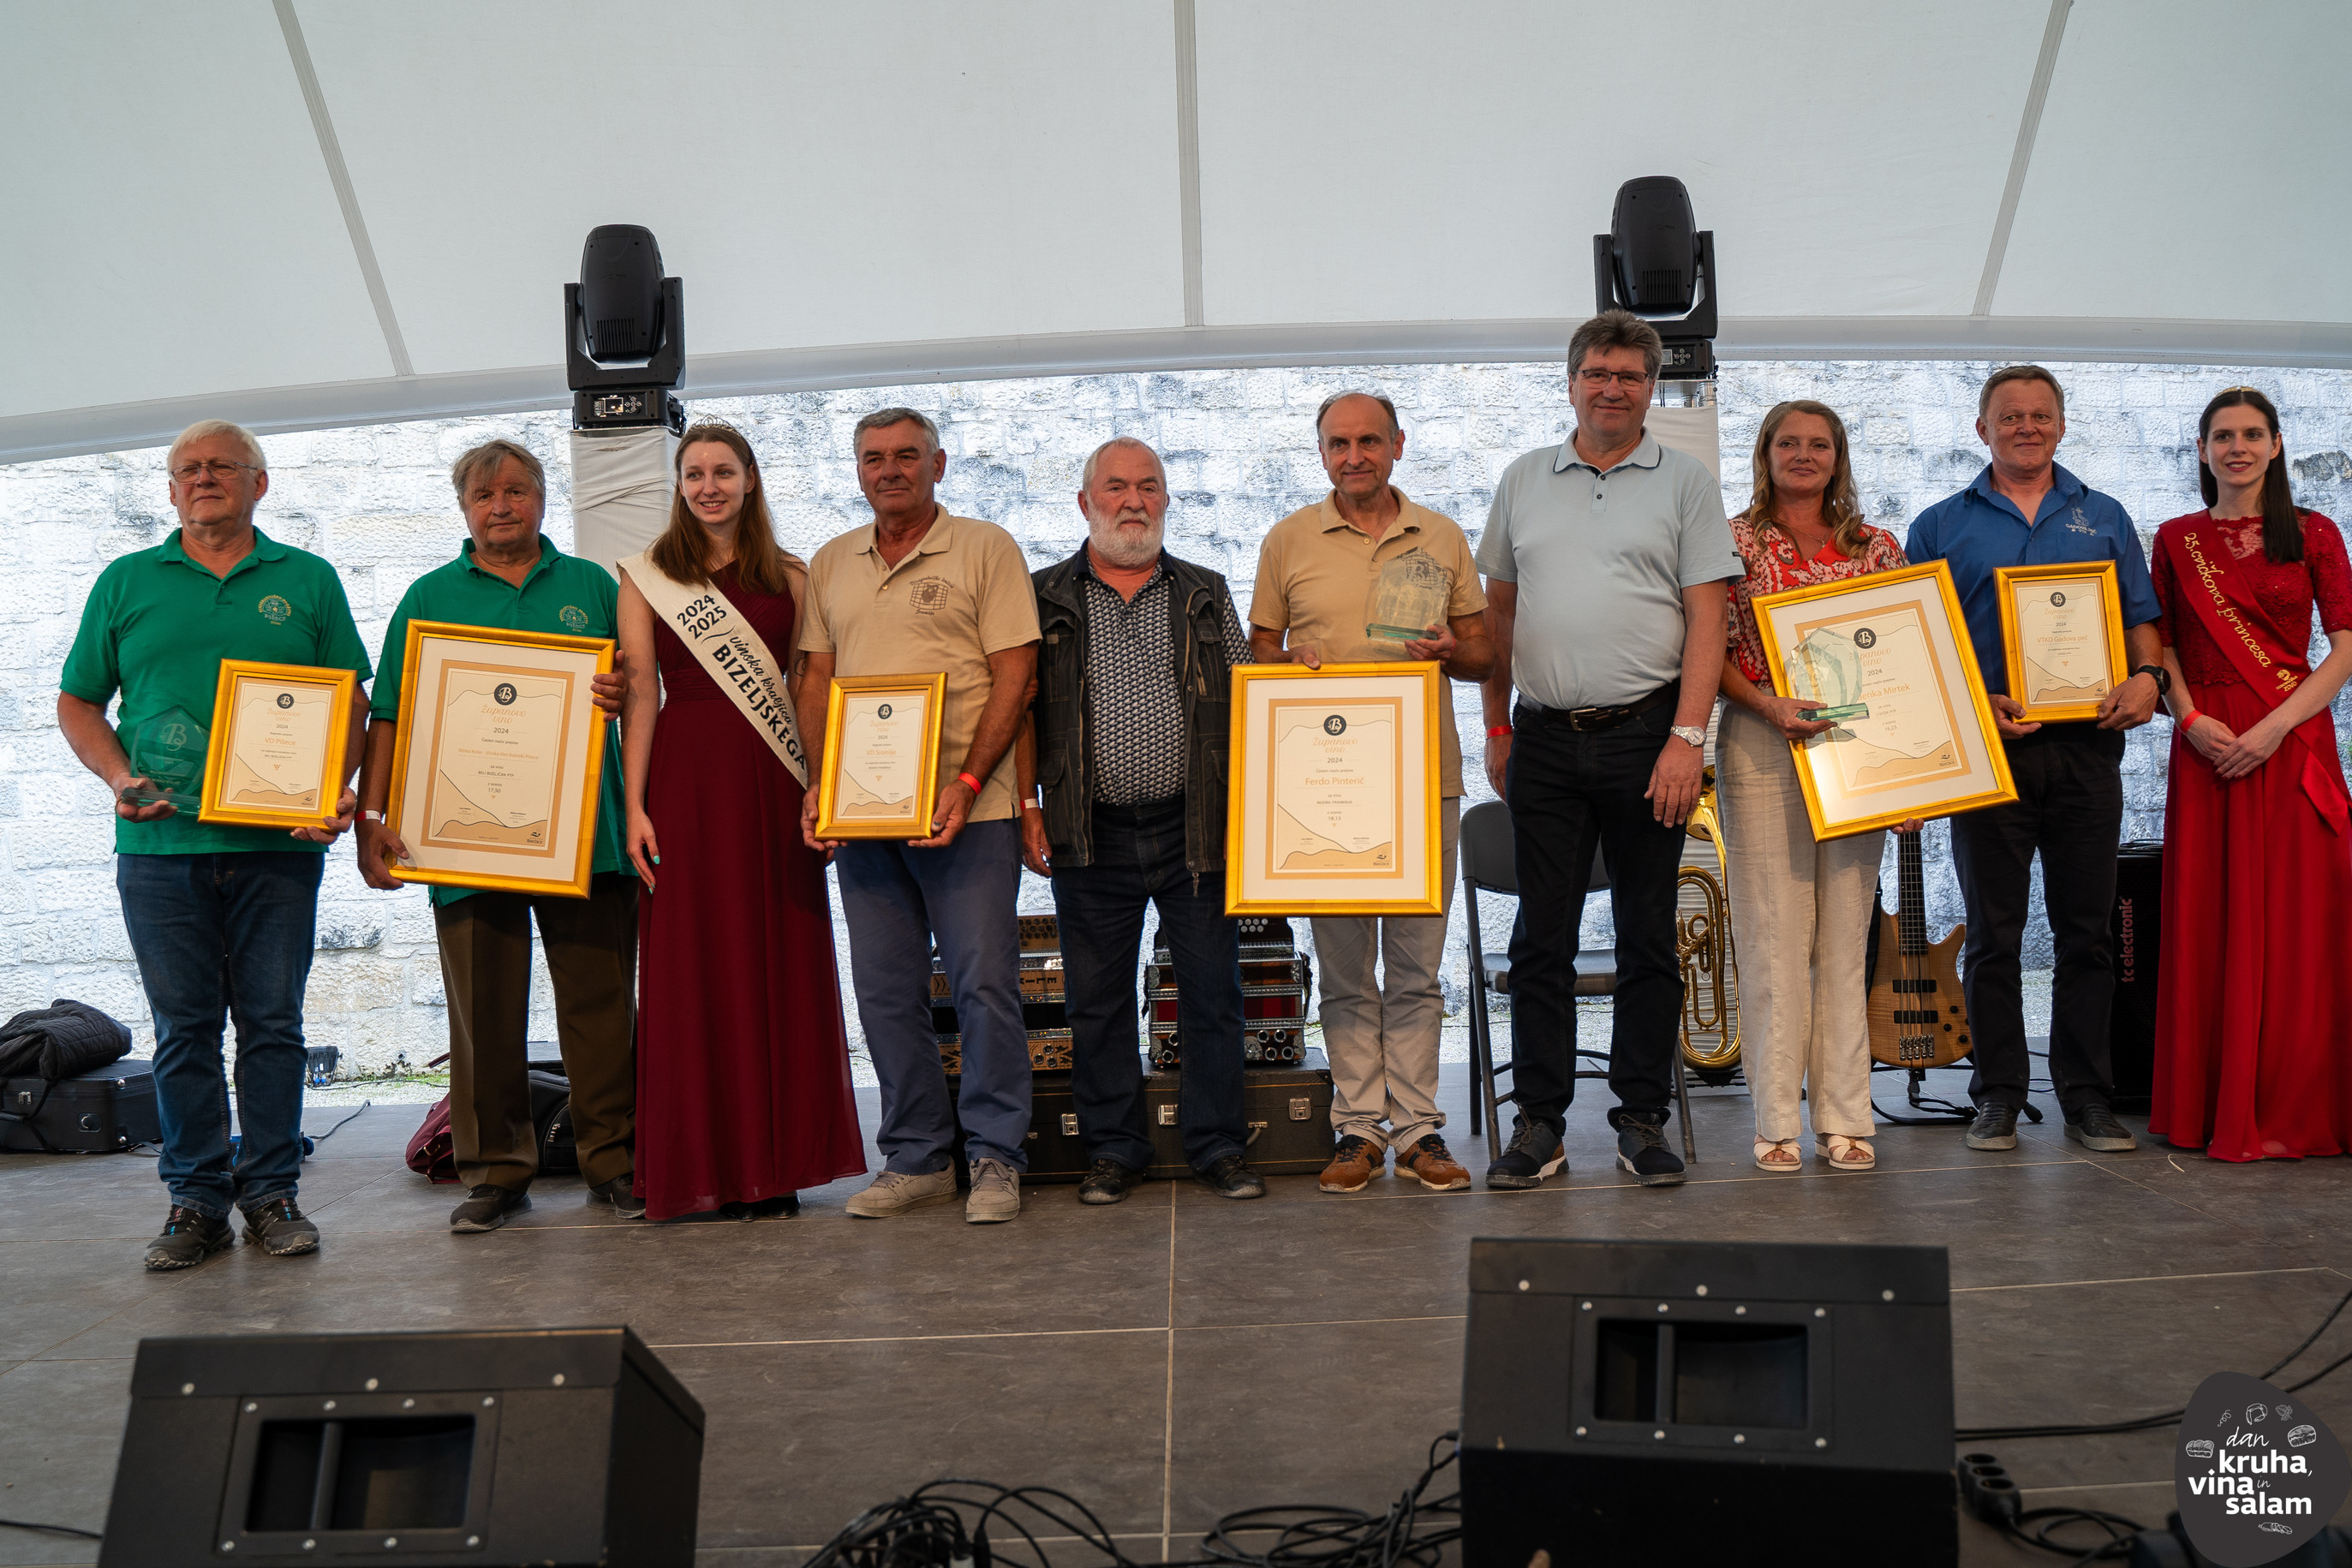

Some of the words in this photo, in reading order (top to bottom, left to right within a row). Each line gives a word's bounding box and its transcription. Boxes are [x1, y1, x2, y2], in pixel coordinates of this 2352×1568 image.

[677, 594, 716, 627] 2024
[688, 605, 727, 640] 2025
[2217, 607, 2271, 668] princesa
[730, 636, 764, 677] vinska
[761, 677, 792, 725] kraljica
[1883, 683, 1911, 695] Mirtek
[712, 644, 806, 771] BIZELJSKEGA
[1305, 777, 1330, 785] Ferdo
[2119, 898, 2134, 967] electronic
